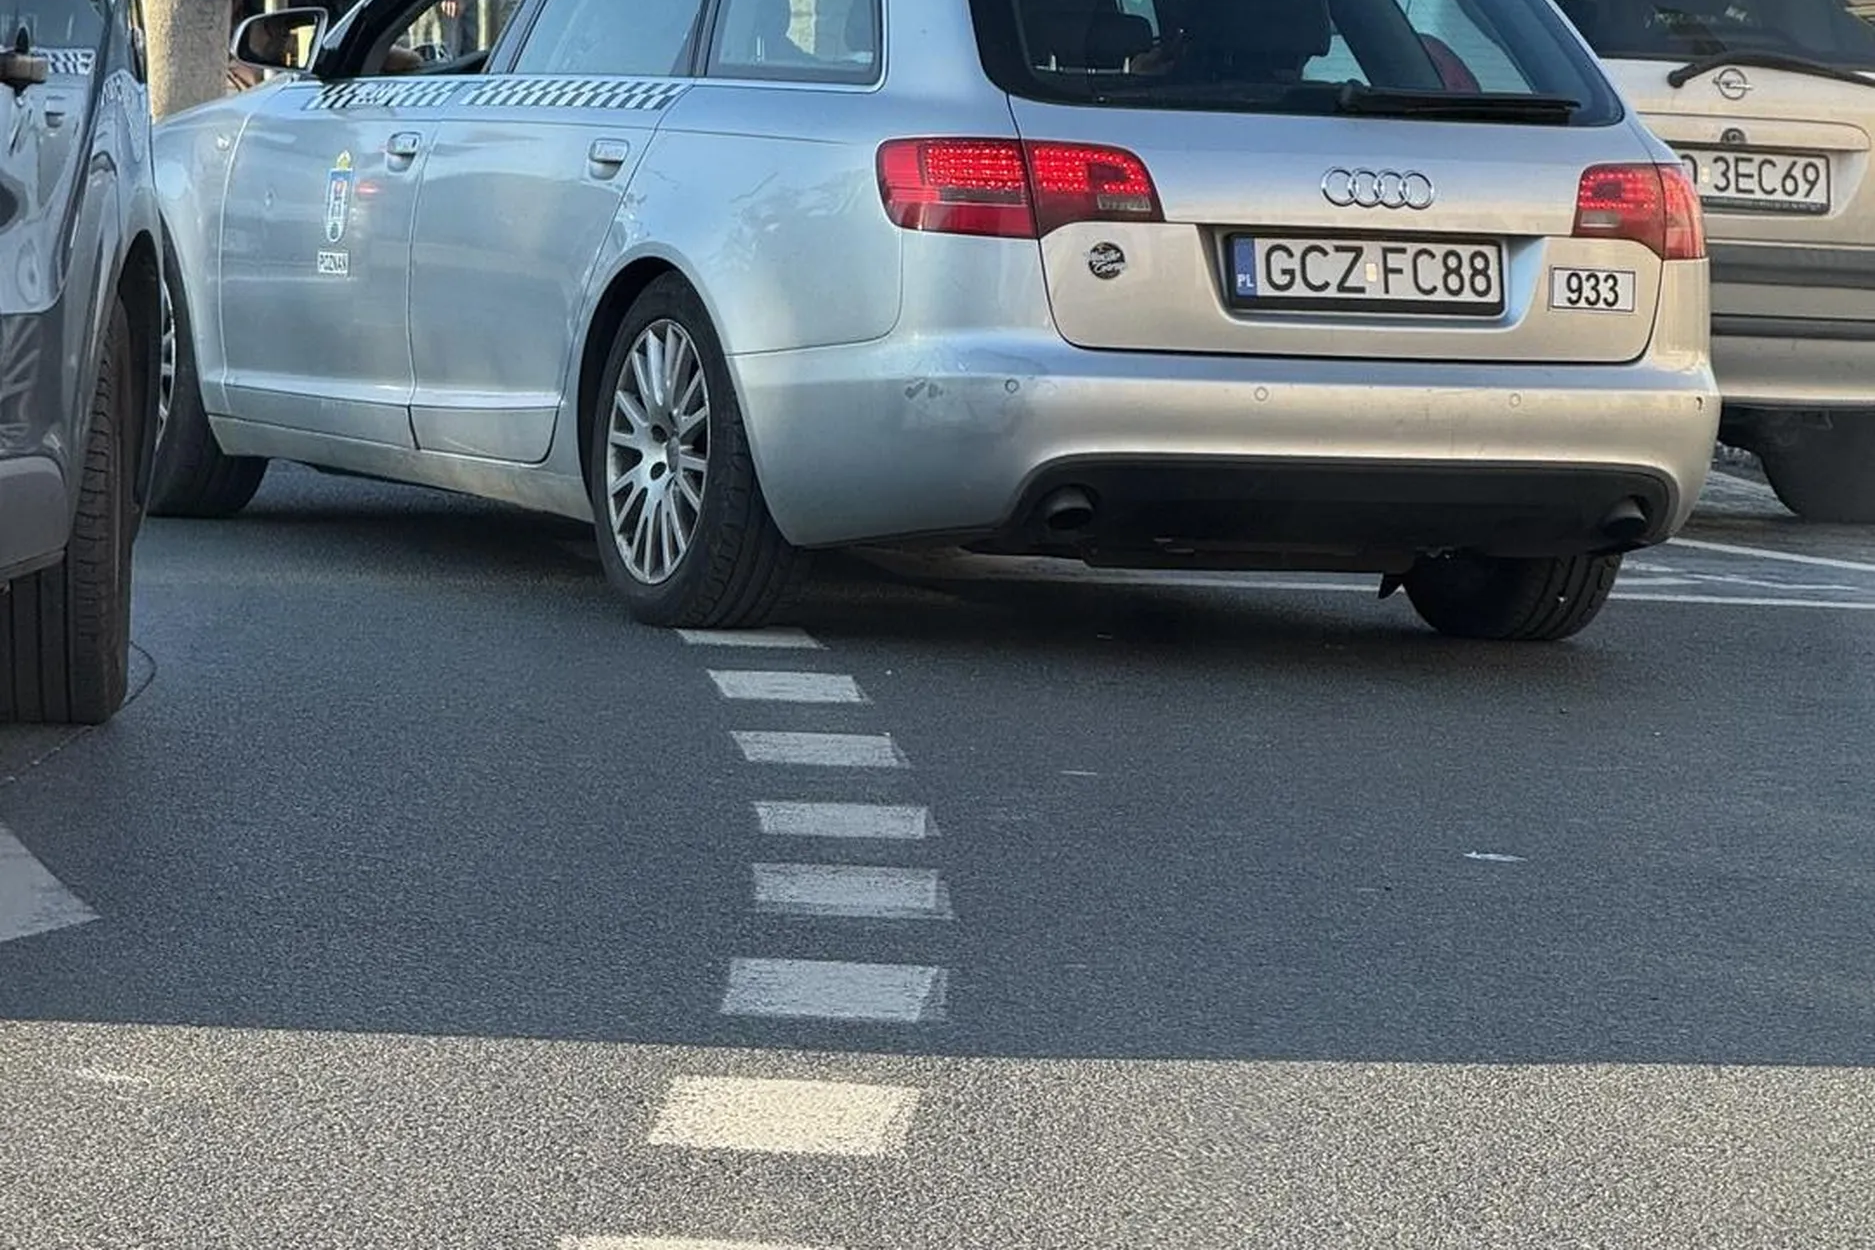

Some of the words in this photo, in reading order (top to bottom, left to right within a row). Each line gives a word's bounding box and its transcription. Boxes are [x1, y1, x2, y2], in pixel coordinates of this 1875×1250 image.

[1712, 155, 1821, 199] 3EC69
[1236, 273, 1255, 288] PL
[1265, 243, 1366, 294] GCZ
[1382, 246, 1493, 298] FC88
[1566, 271, 1620, 308] 933
